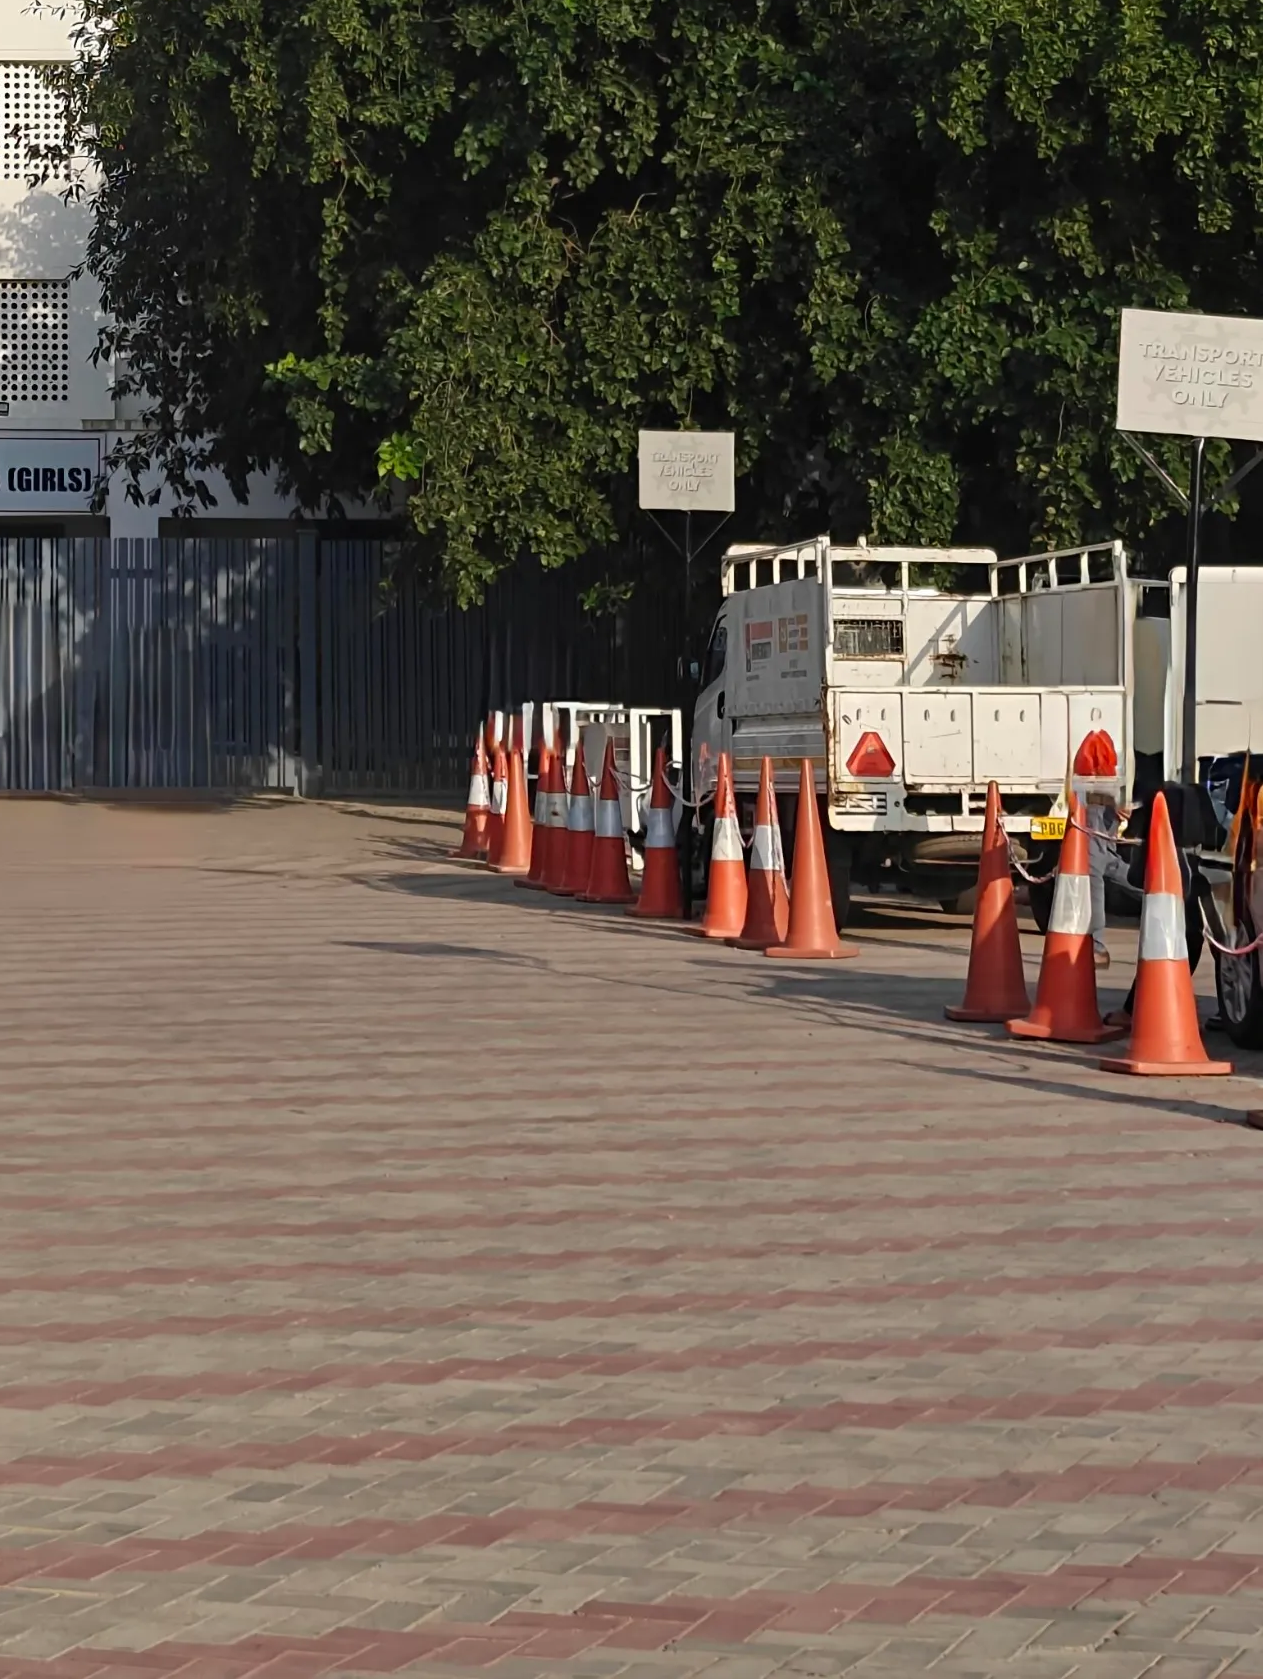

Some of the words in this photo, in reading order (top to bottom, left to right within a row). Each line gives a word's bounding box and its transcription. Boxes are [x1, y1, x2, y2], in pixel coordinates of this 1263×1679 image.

[1138, 341, 1263, 368] TRANSPORT
[1155, 364, 1254, 389] VEHICLES
[8, 467, 92, 492] (GIRLS)
